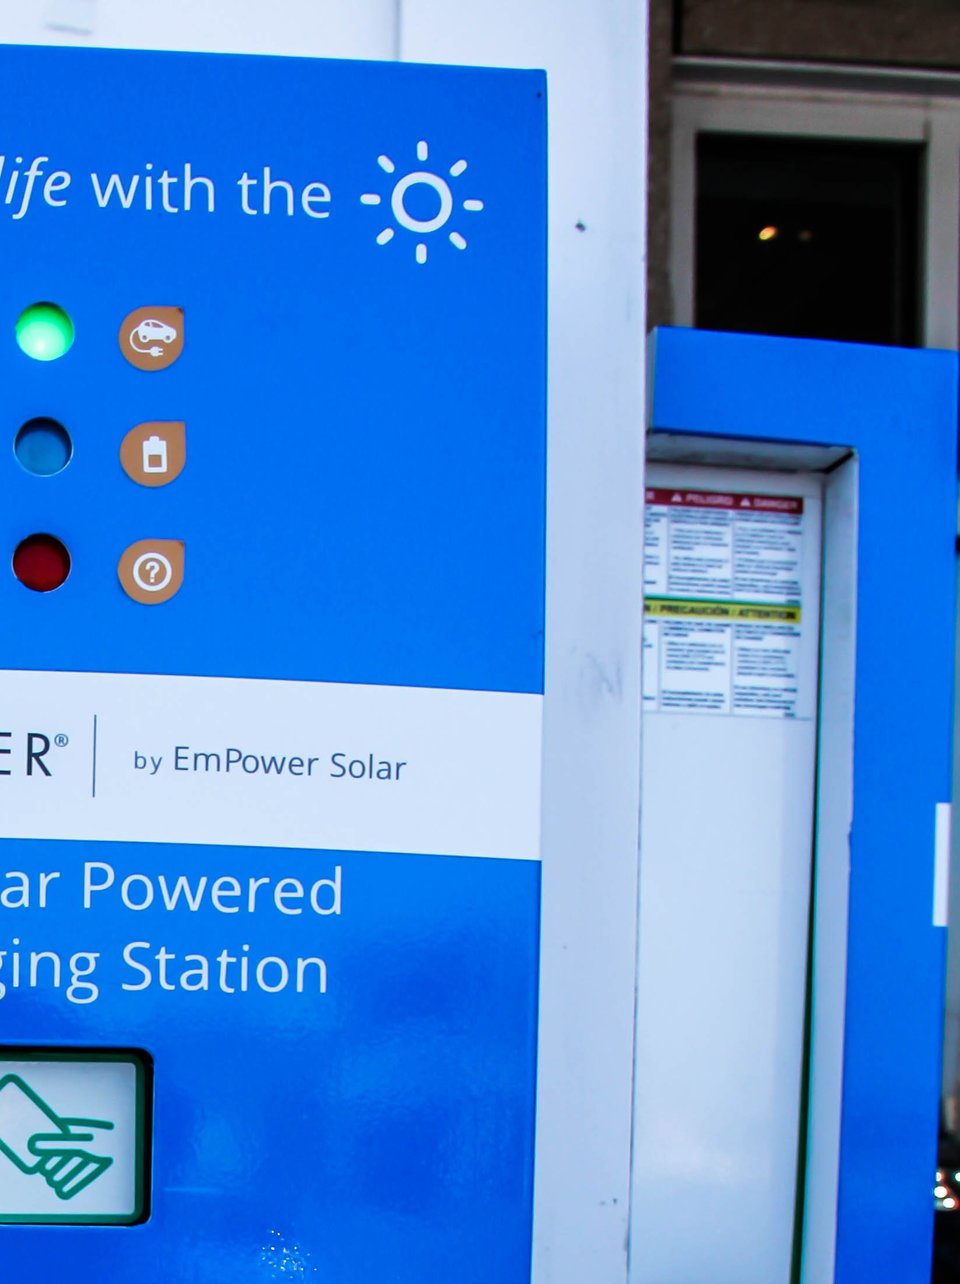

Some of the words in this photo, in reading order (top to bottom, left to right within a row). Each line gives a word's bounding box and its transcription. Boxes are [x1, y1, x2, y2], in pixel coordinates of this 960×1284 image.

[90, 162, 215, 213] with
[237, 166, 331, 219] the
[134, 750, 163, 776] by
[174, 745, 320, 777] EmPower
[329, 752, 408, 781] Solar
[83, 861, 342, 915] Powered
[121, 941, 327, 993] Station
